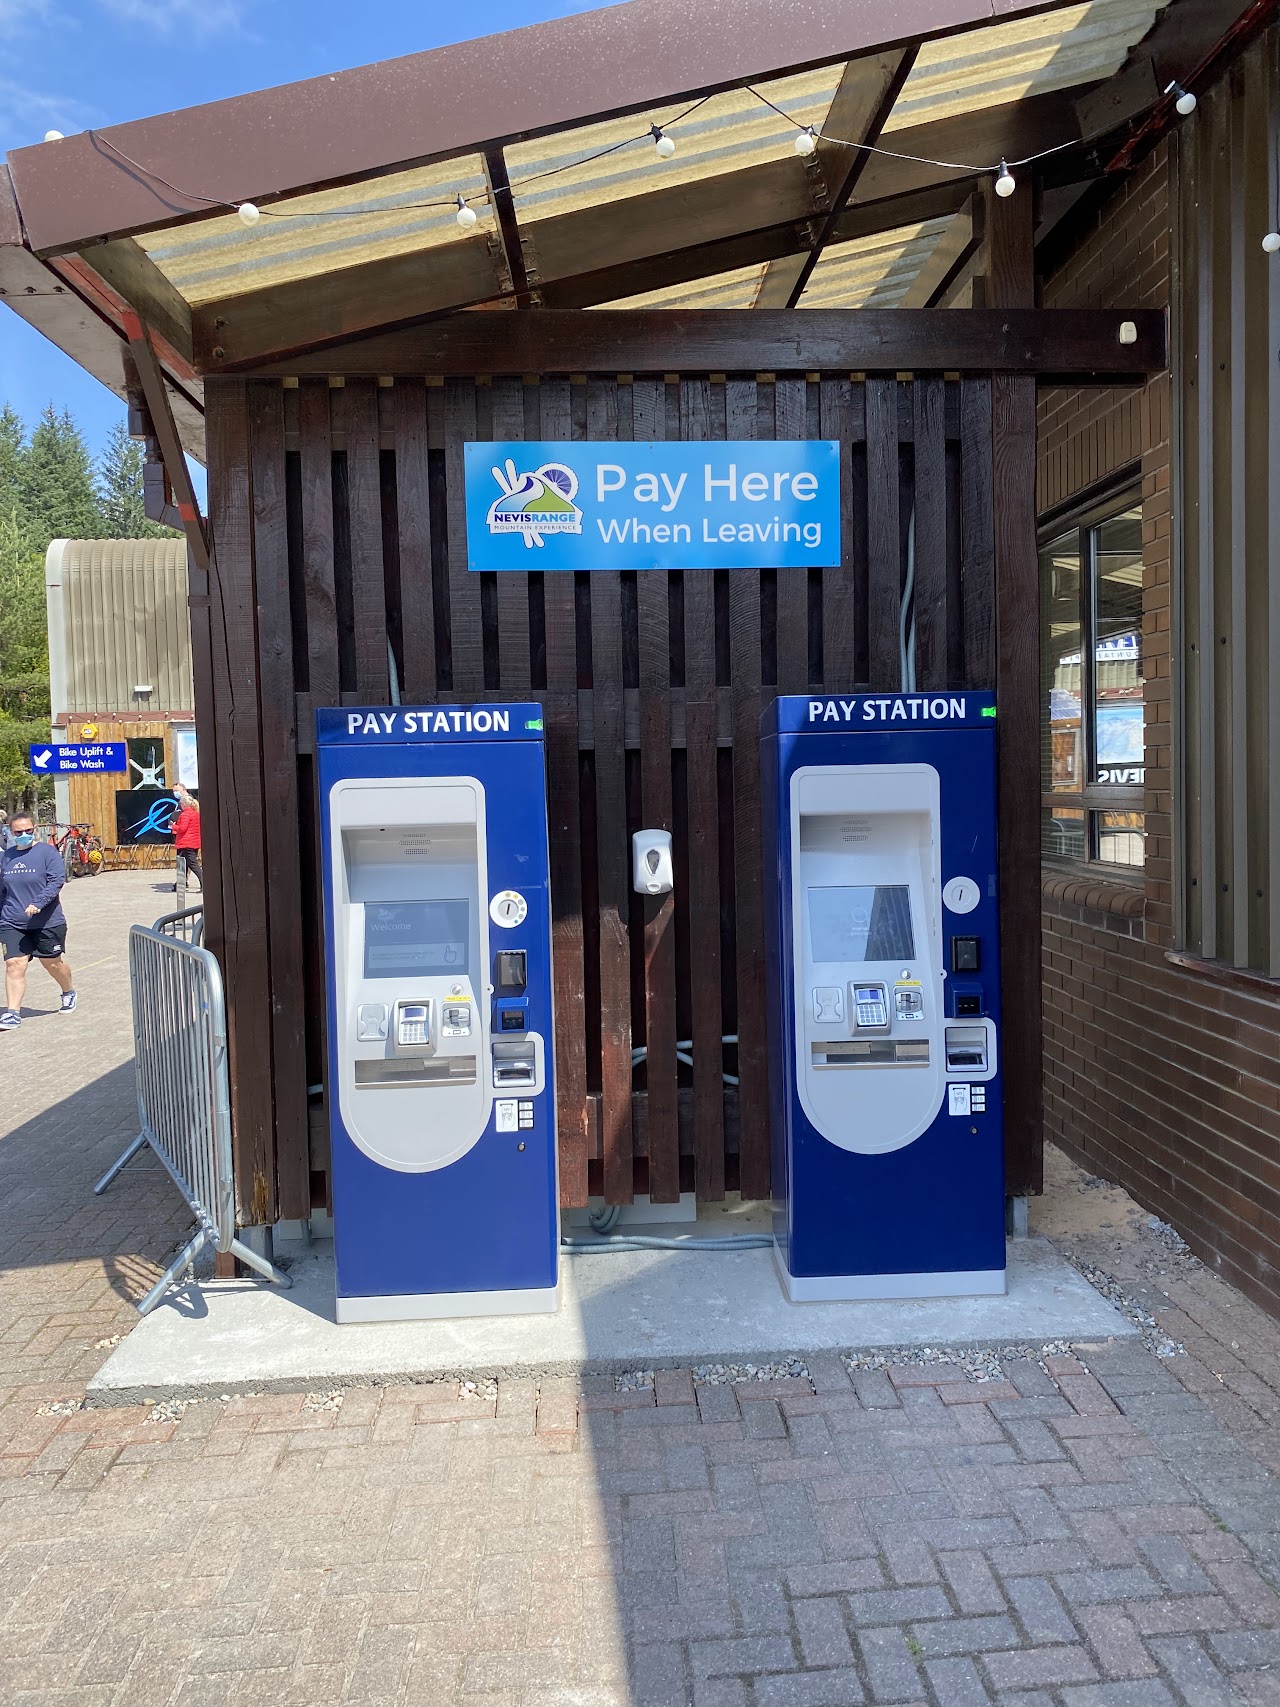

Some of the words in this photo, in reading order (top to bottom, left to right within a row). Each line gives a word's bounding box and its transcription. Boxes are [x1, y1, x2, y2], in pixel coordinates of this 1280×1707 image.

[597, 464, 687, 512] Pay
[704, 464, 819, 502] Here
[597, 518, 691, 544] When
[703, 516, 822, 548] Leaving
[809, 700, 856, 722] PAY
[862, 698, 966, 721] STATION
[347, 712, 397, 735] PAY
[404, 711, 510, 733] STATION
[59, 747, 77, 756] Bike
[80, 746, 103, 758] Uplift
[106, 746, 114, 756] &
[60, 760, 78, 769] Bike
[80, 759, 104, 769] Wash
[370, 922, 412, 931] Welcome
